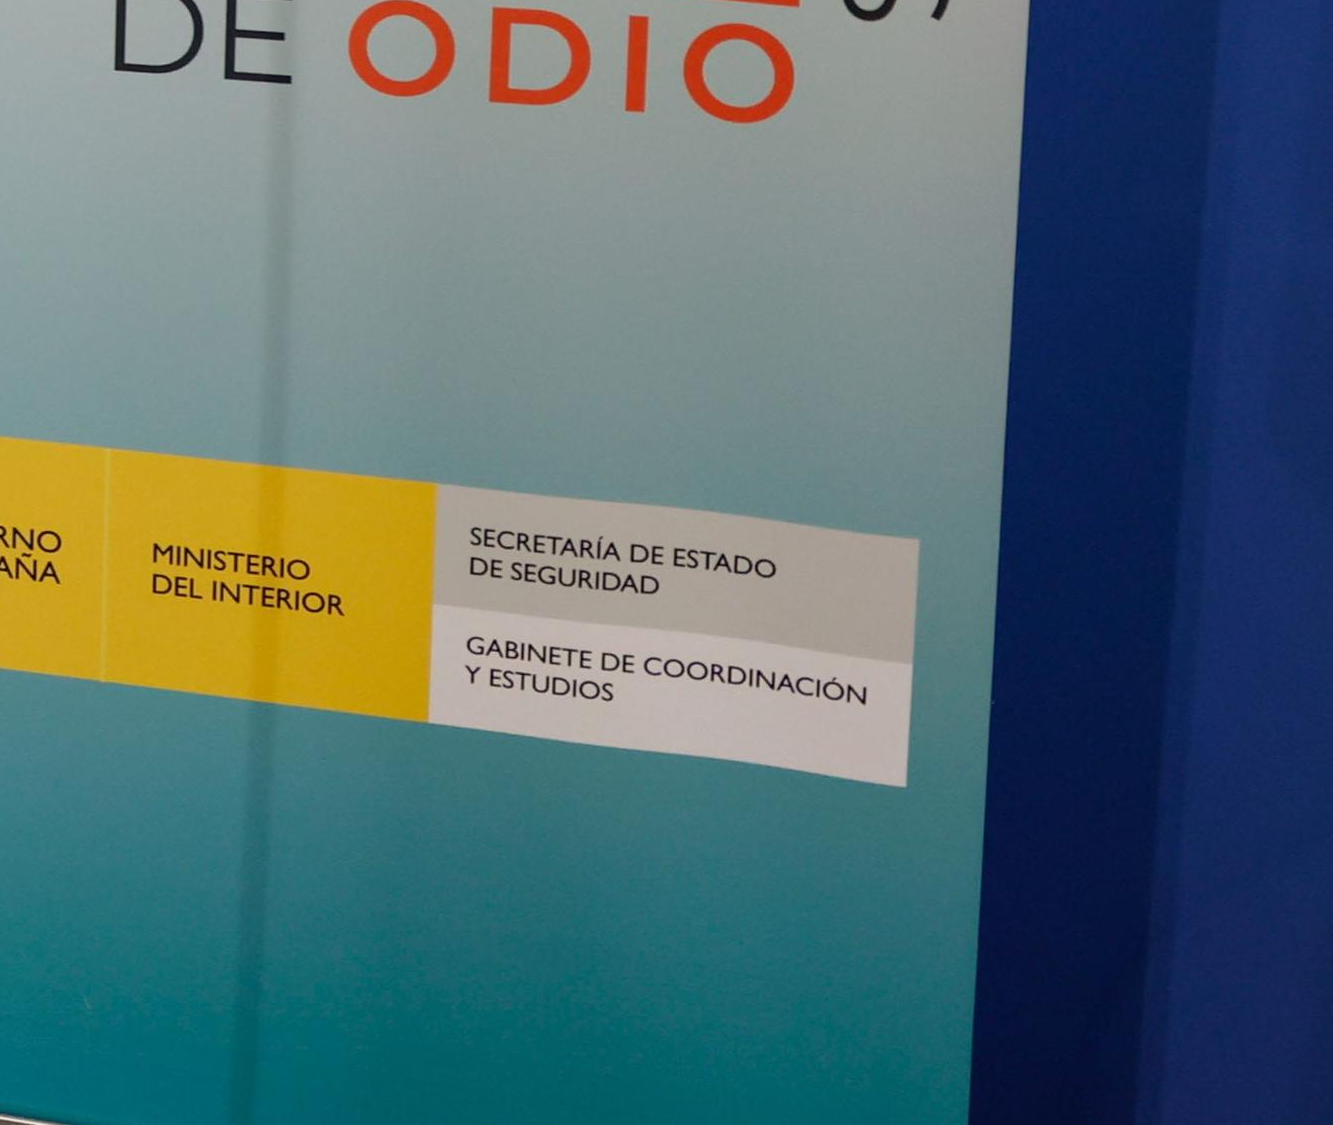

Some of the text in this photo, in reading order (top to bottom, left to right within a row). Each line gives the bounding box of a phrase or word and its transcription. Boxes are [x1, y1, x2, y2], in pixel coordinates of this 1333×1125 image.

[349, 0, 795, 124] ODIO
[152, 543, 310, 580] MINISTERIO
[470, 527, 777, 579] SECRETARÍA DE ESTADO
[152, 573, 345, 616] DEL INTERIOR
[469, 556, 660, 595] DE SEGURIDAD
[465, 665, 615, 702] Y ESTUDIOS
[466, 636, 868, 705] GABINETE DE COORDINACIÓN
